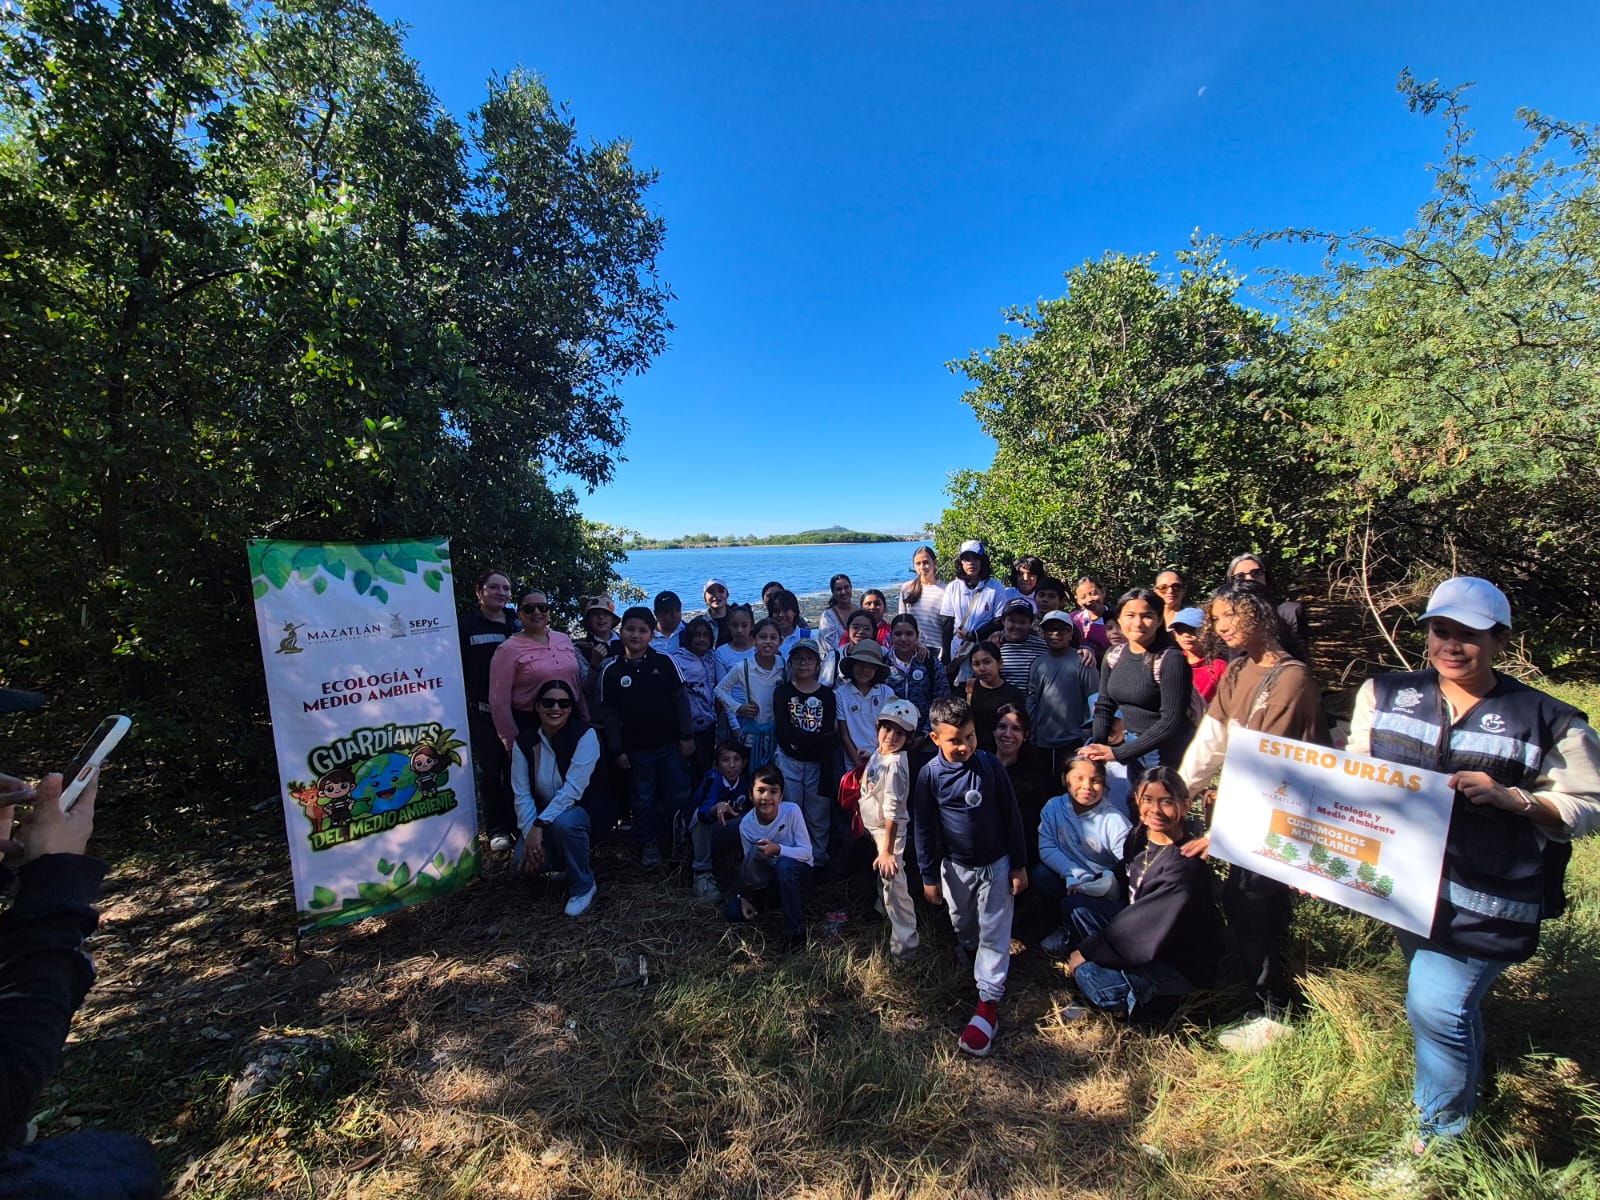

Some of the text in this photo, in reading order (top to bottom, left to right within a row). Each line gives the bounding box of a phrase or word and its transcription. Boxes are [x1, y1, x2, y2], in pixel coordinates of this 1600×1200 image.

[307, 624, 381, 640] MAZATLÁN
[409, 617, 439, 628] SEPyC
[322, 667, 424, 694] ECOLOGÍA Y
[303, 677, 443, 713] MEDIO AMBIENTE
[787, 702, 824, 719] PEACE
[1259, 738, 1422, 791] ESTERO URÍAS
[313, 791, 456, 849] DEL MEDIO AMBIENTE
[1287, 817, 1366, 848] CUIDEMOS LOS
[1317, 806, 1395, 835] Medio Ambiente
[1291, 828, 1357, 855] MANGLARES
